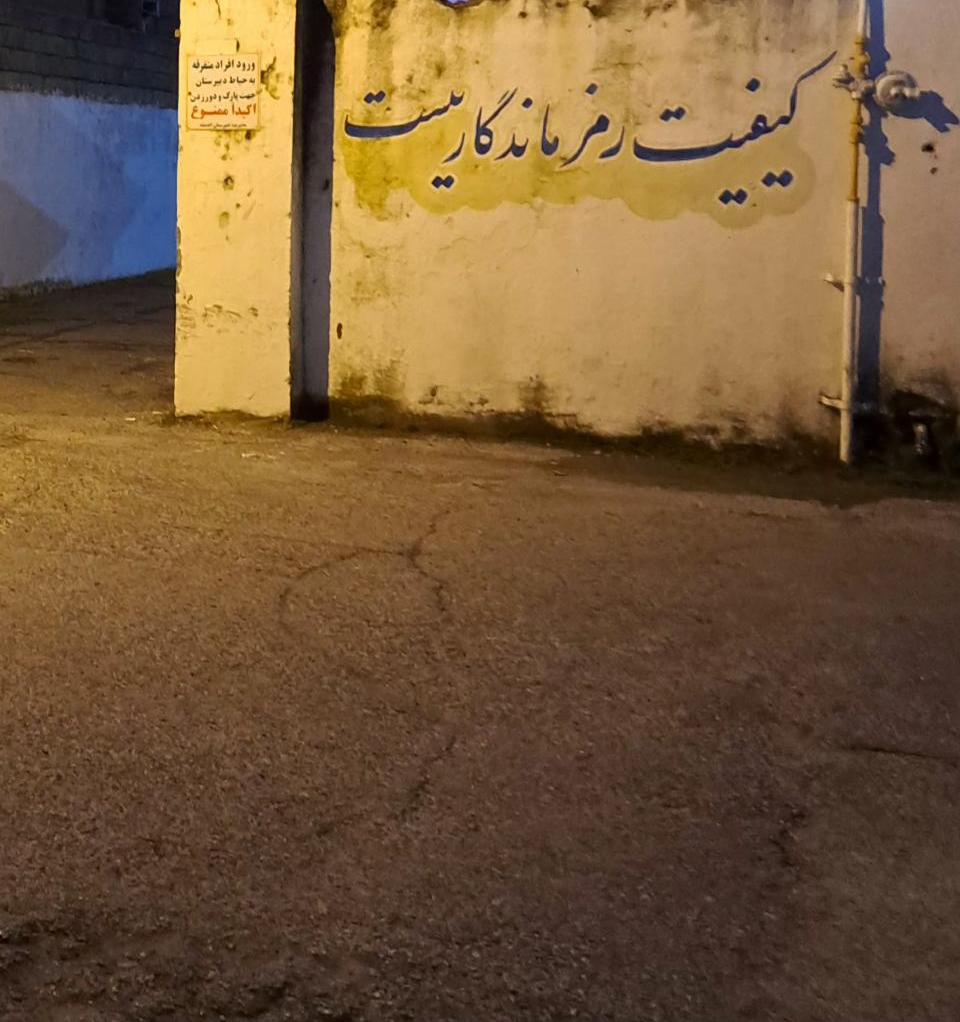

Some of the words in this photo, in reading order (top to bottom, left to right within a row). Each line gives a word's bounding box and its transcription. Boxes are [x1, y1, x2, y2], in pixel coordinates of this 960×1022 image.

[191, 59, 214, 73] متفرقه
[215, 58, 235, 72] افراد
[236, 60, 256, 72] ورود
[190, 104, 230, 119] ممنوع
[559, 81, 626, 170] رمز
[632, 49, 838, 206] کیفیت
